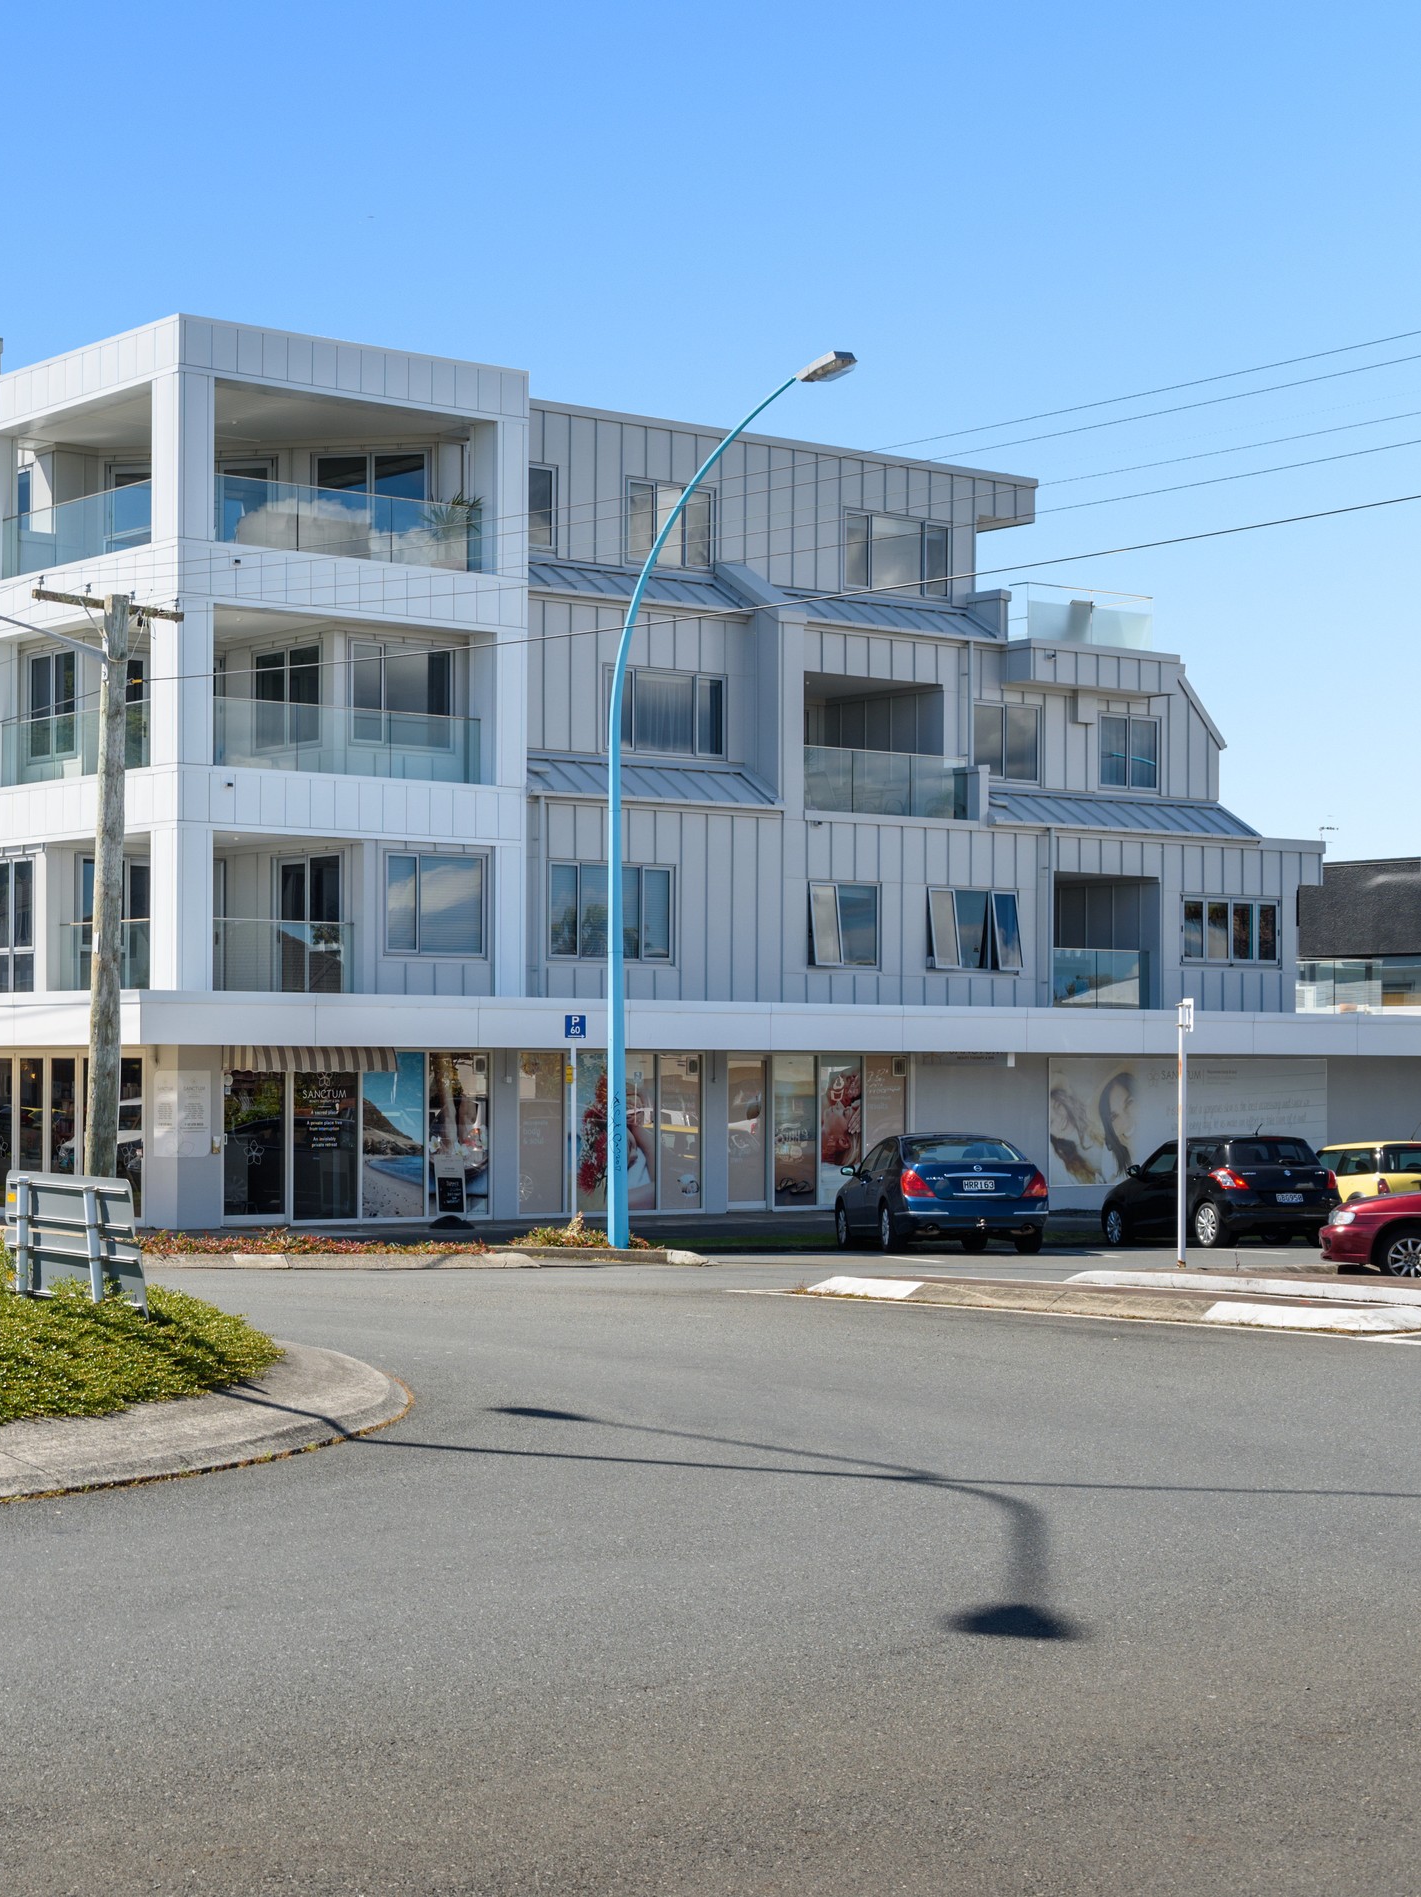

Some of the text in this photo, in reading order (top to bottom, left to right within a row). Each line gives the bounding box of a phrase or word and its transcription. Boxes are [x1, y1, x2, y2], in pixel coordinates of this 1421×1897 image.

[571, 1016, 580, 1025] P
[570, 1026, 581, 1034] 60
[302, 1089, 347, 1099] SANCTUM
[964, 1181, 995, 1190] HRR163
